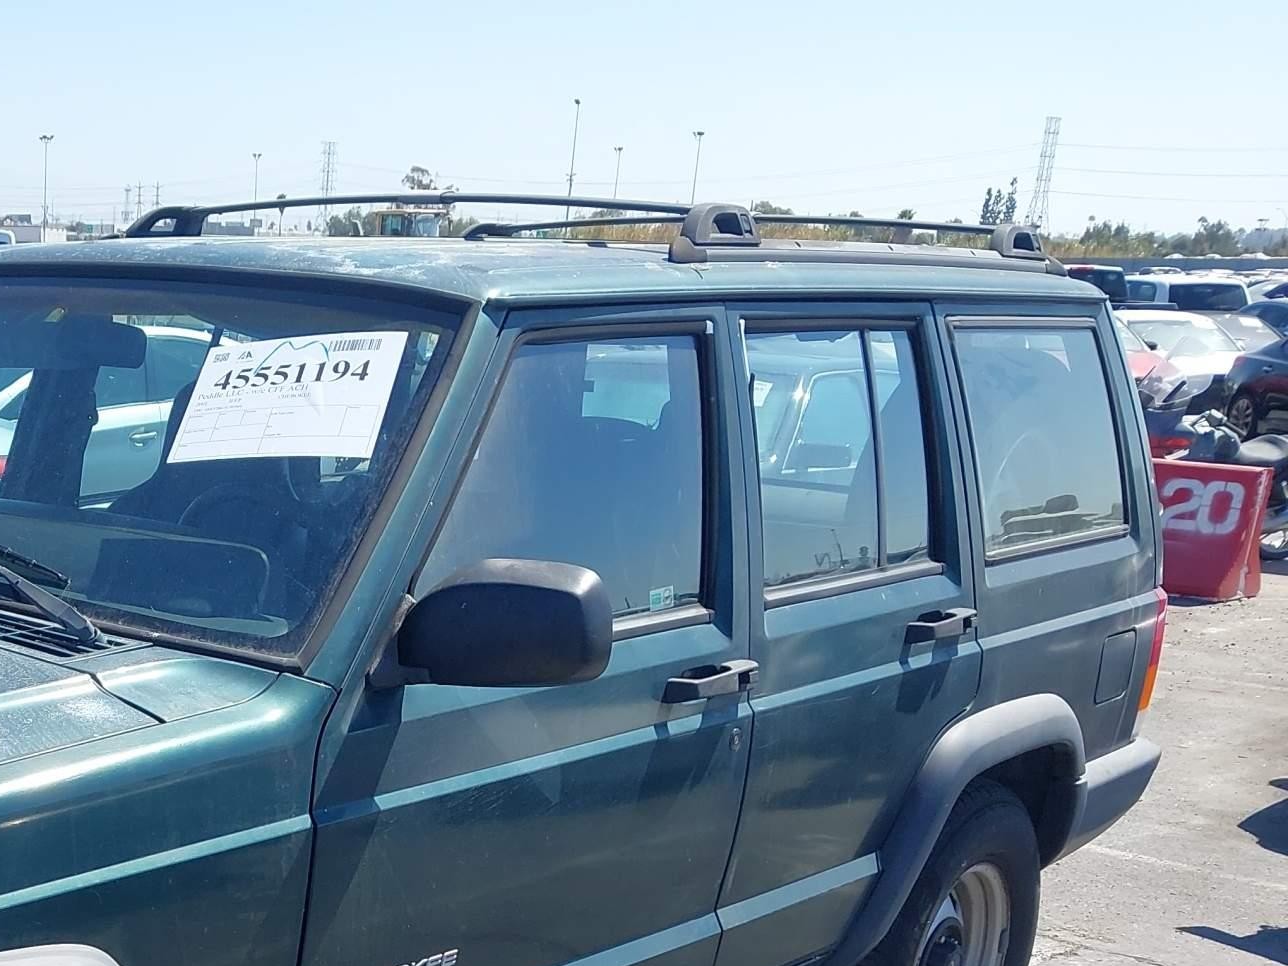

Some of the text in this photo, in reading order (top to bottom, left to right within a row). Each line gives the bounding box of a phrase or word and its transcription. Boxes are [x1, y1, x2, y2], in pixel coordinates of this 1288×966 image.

[213, 359, 371, 390] 45551194
[225, 387, 245, 398] LLC
[1162, 478, 1245, 535] 20
